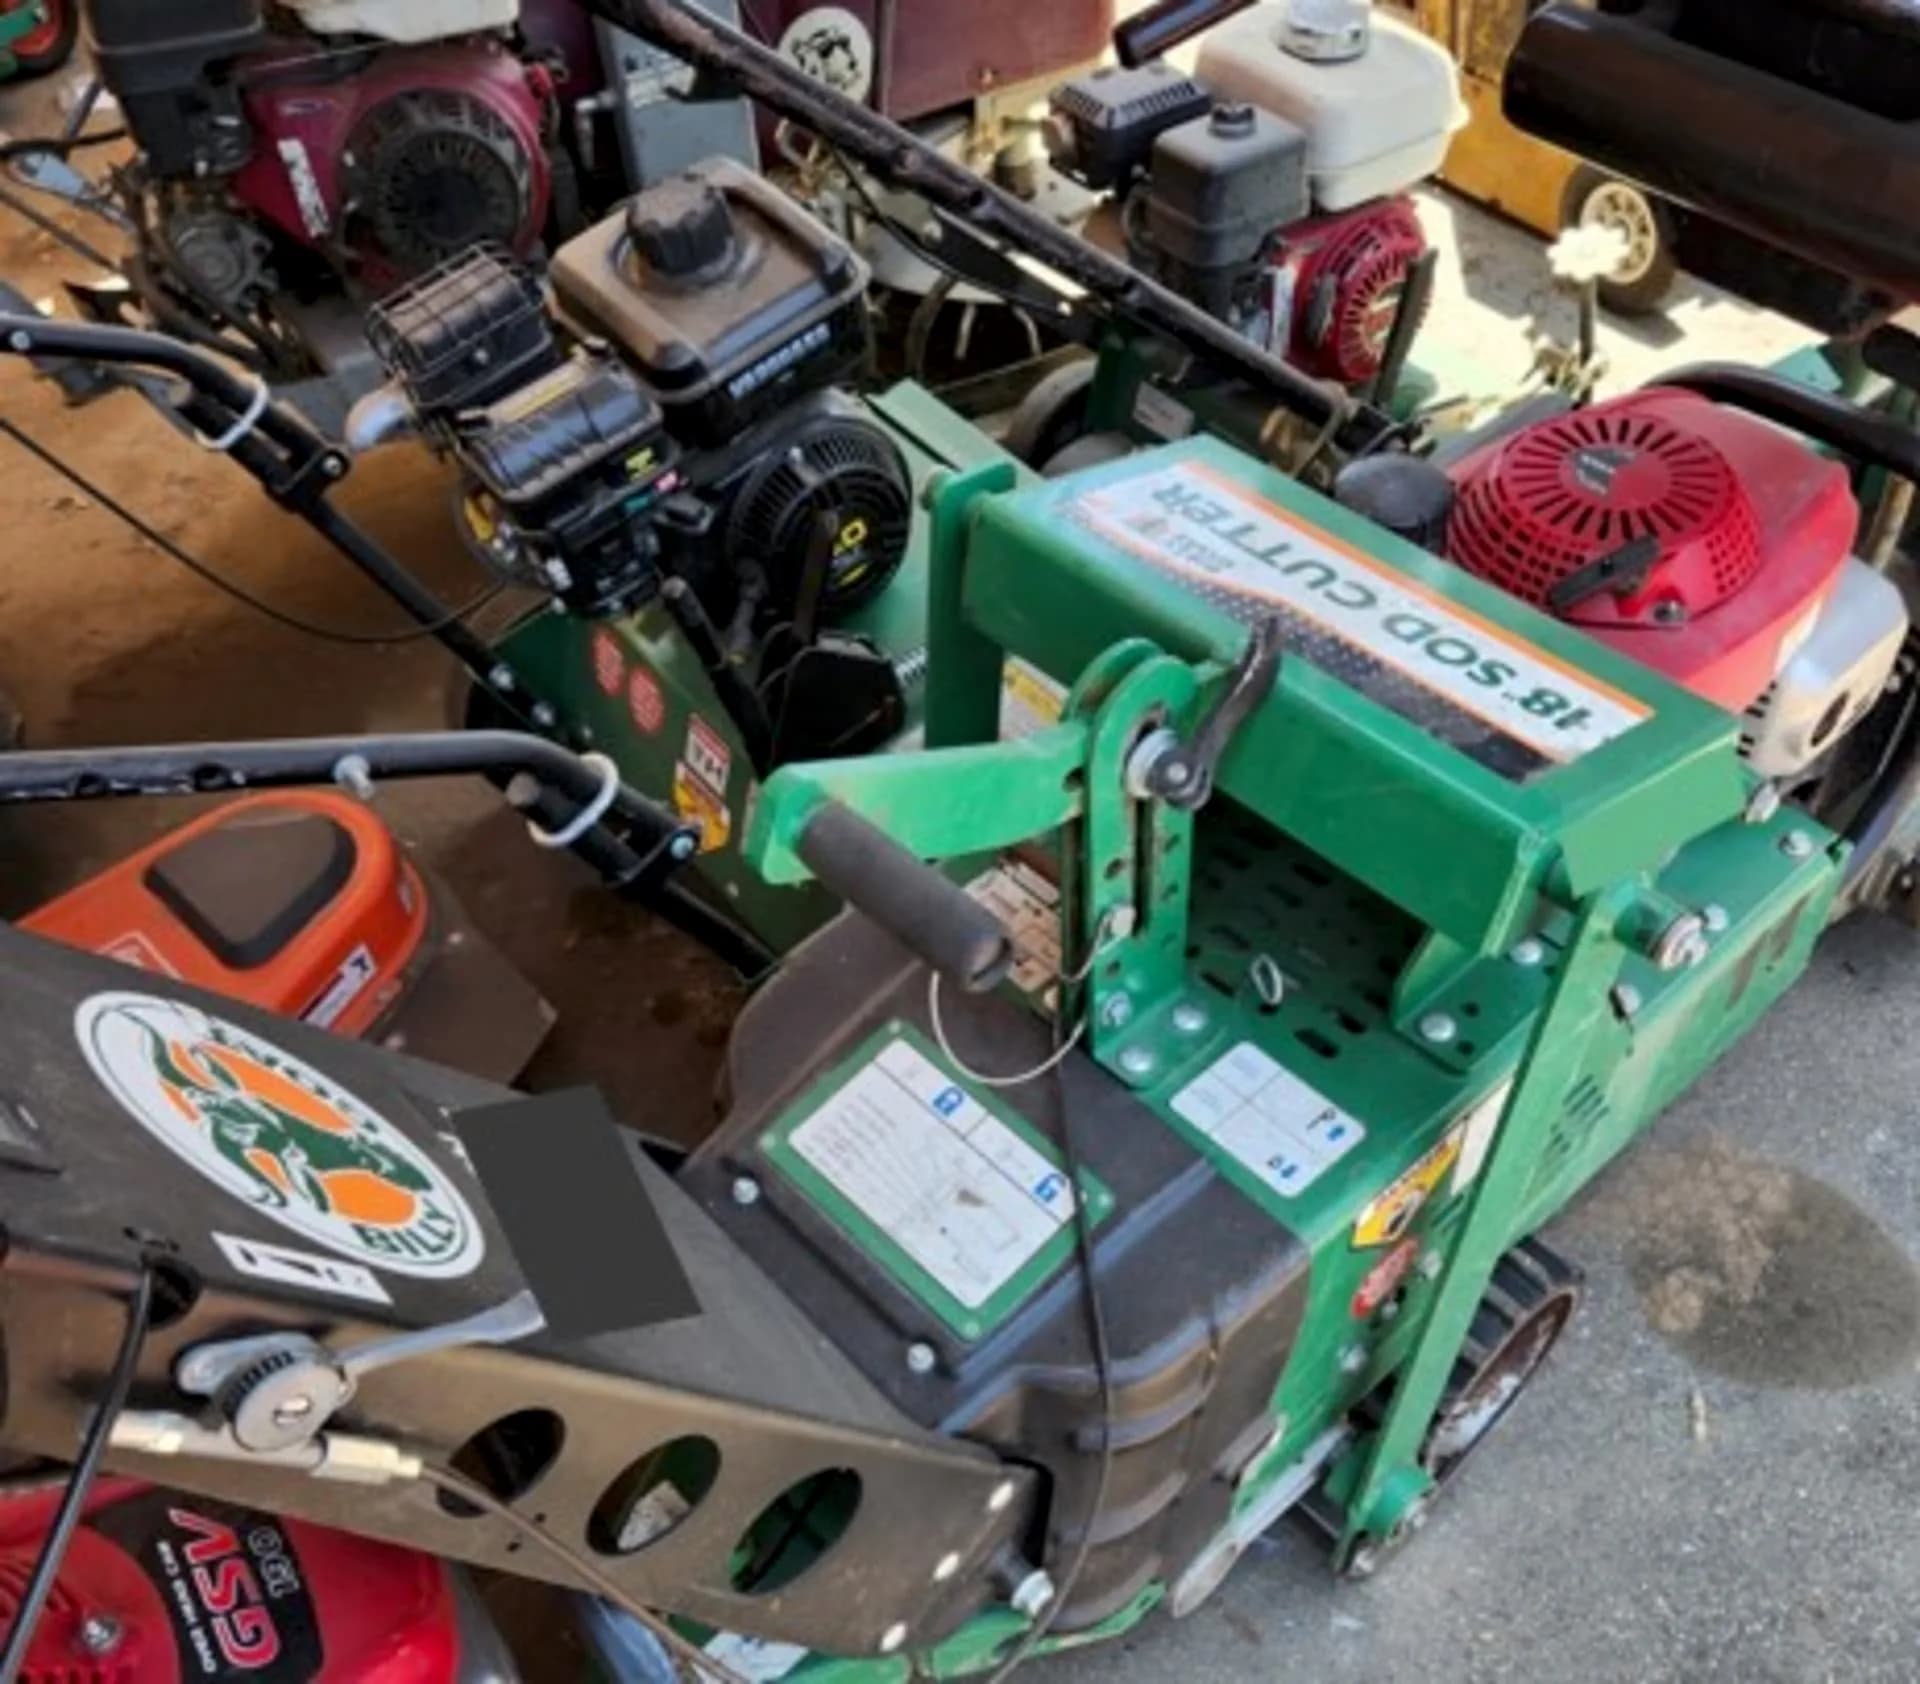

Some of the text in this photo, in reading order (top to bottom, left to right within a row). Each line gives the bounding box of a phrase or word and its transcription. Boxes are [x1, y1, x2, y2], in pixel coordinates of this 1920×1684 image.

[1152, 483, 1379, 610] CUTTER
[1381, 612, 1518, 687] SOD
[169, 1508, 279, 1667] GSV
